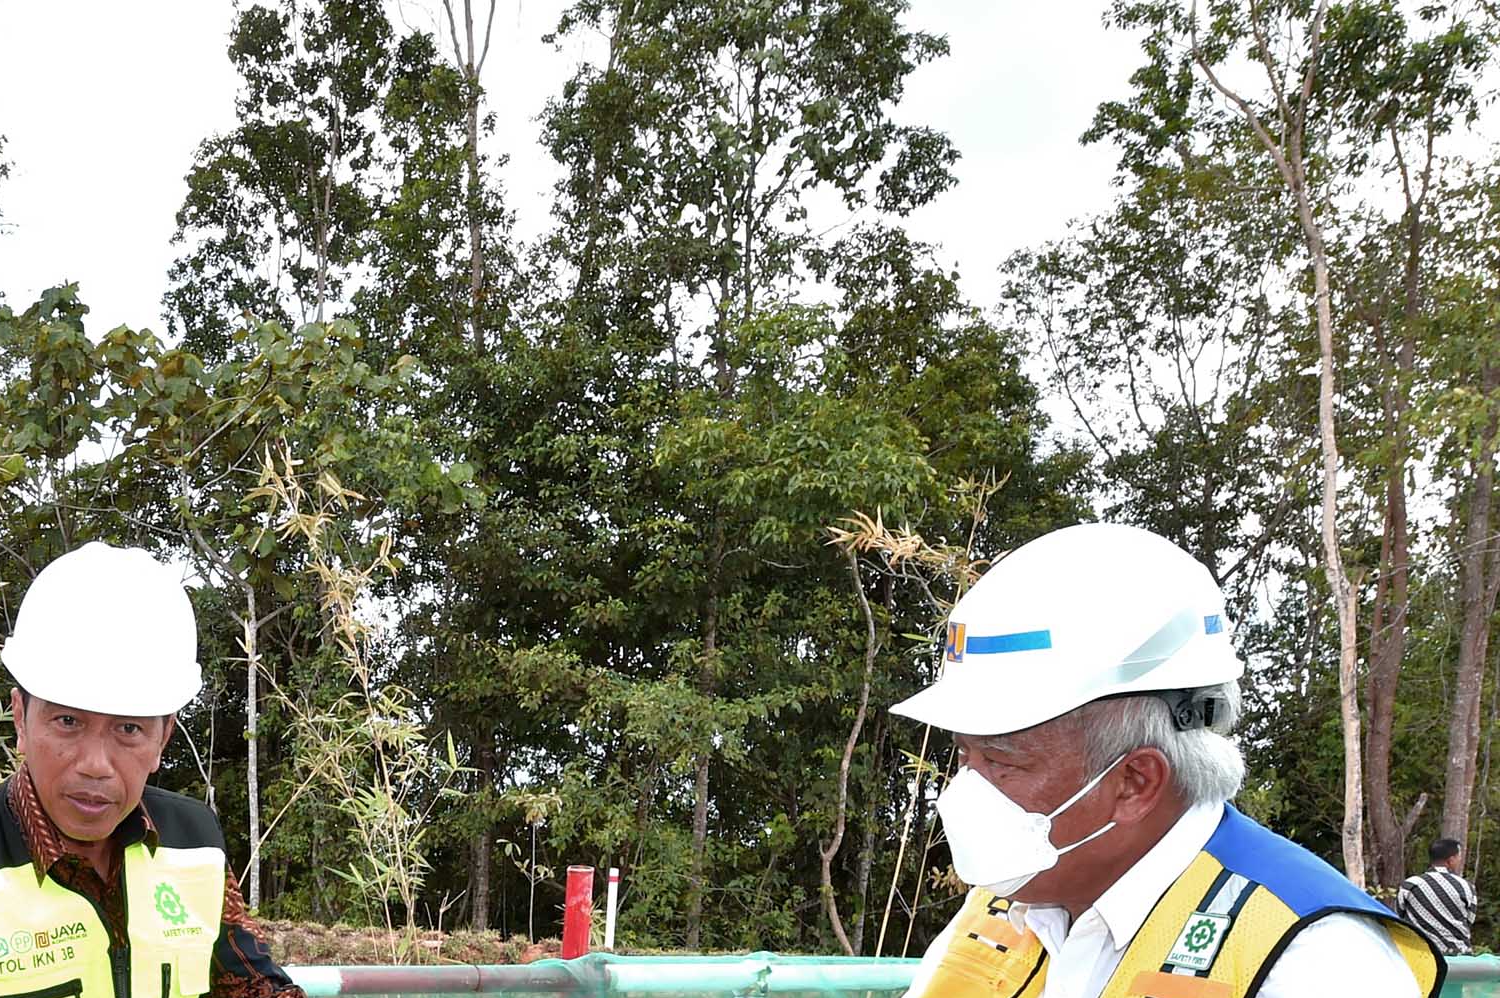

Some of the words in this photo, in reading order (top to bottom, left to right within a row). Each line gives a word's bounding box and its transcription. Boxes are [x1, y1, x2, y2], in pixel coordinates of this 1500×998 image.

[50, 922, 86, 940] JAYA
[163, 928, 186, 938] SAFETY
[186, 927, 203, 936] FIRST
[32, 951, 56, 969] IKN
[1170, 952, 1192, 963] SAFETY
[1191, 956, 1208, 966] FIRST
